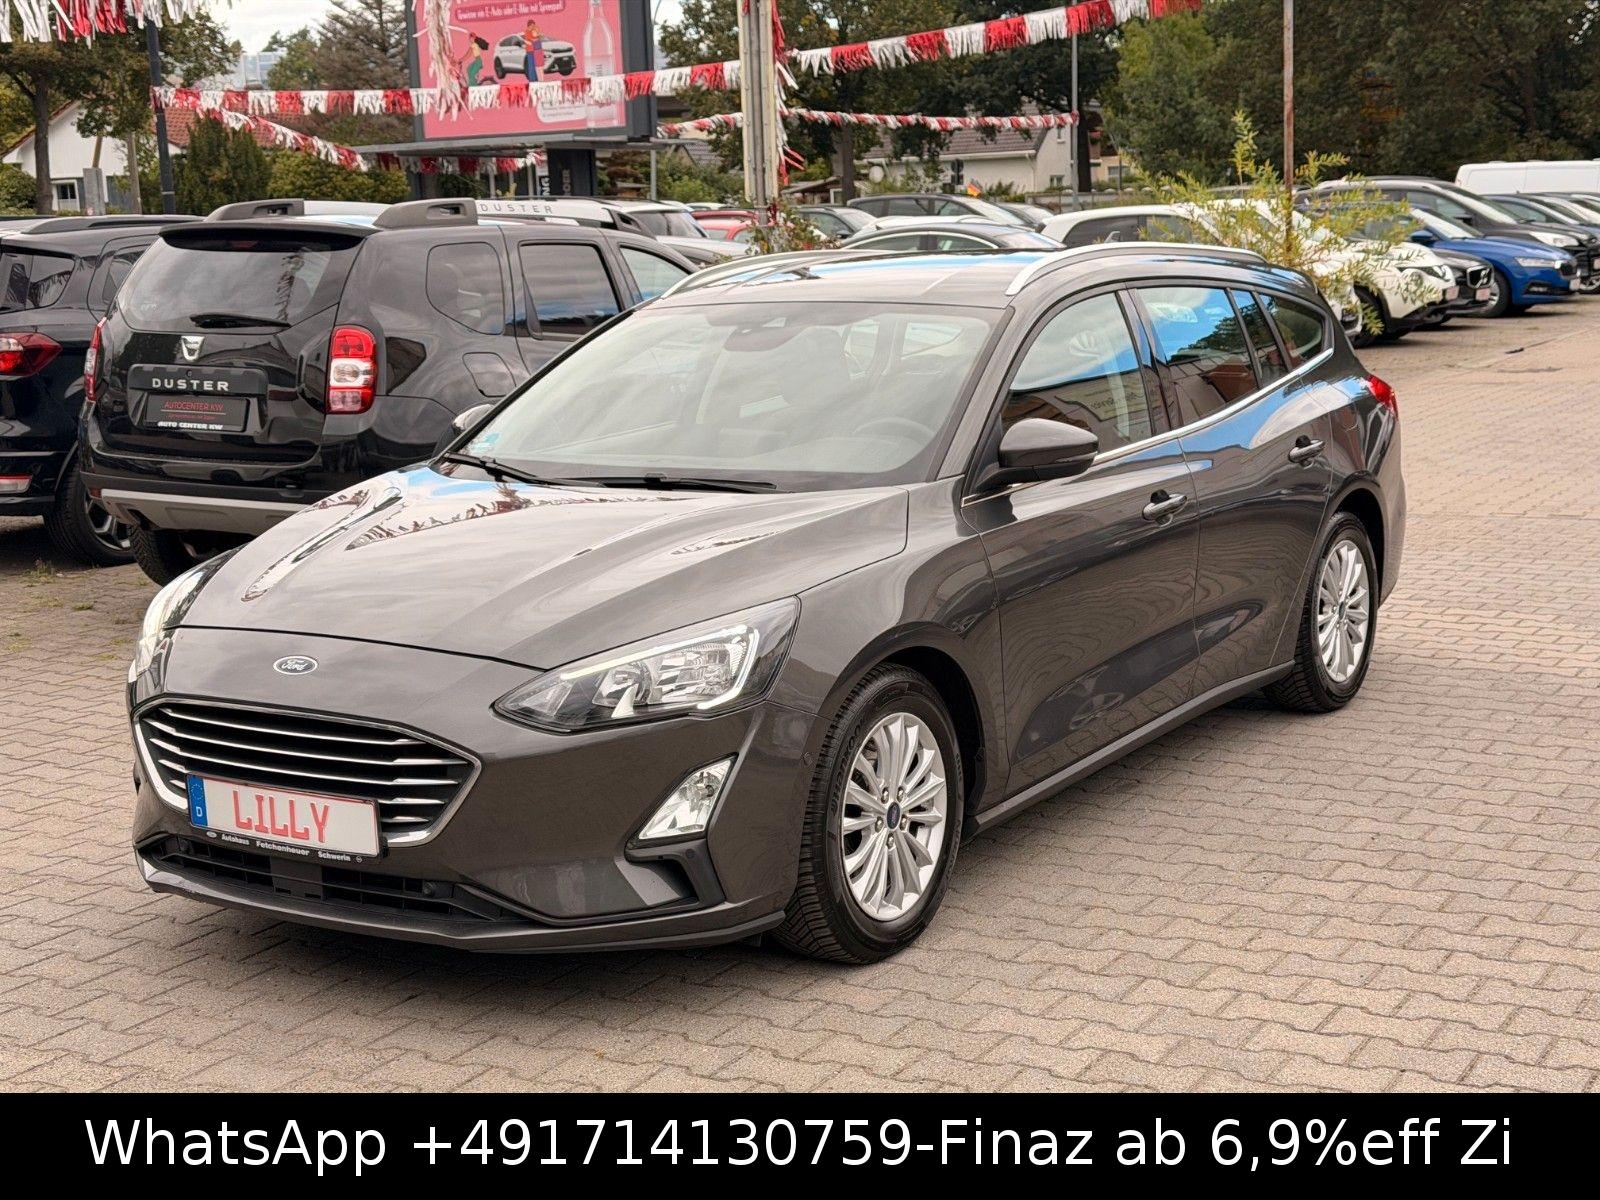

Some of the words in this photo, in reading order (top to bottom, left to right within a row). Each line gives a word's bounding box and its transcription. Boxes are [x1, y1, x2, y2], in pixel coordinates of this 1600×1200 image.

[480, 203, 552, 214] DUSTER
[152, 378, 229, 391] DUSTER
[164, 401, 209, 411] AUTOCENTER
[179, 422, 208, 430] CENTER
[196, 806, 202, 817] D
[232, 790, 330, 843] LILLY
[221, 833, 250, 846] Autohaus
[318, 850, 351, 862] Schwerin
